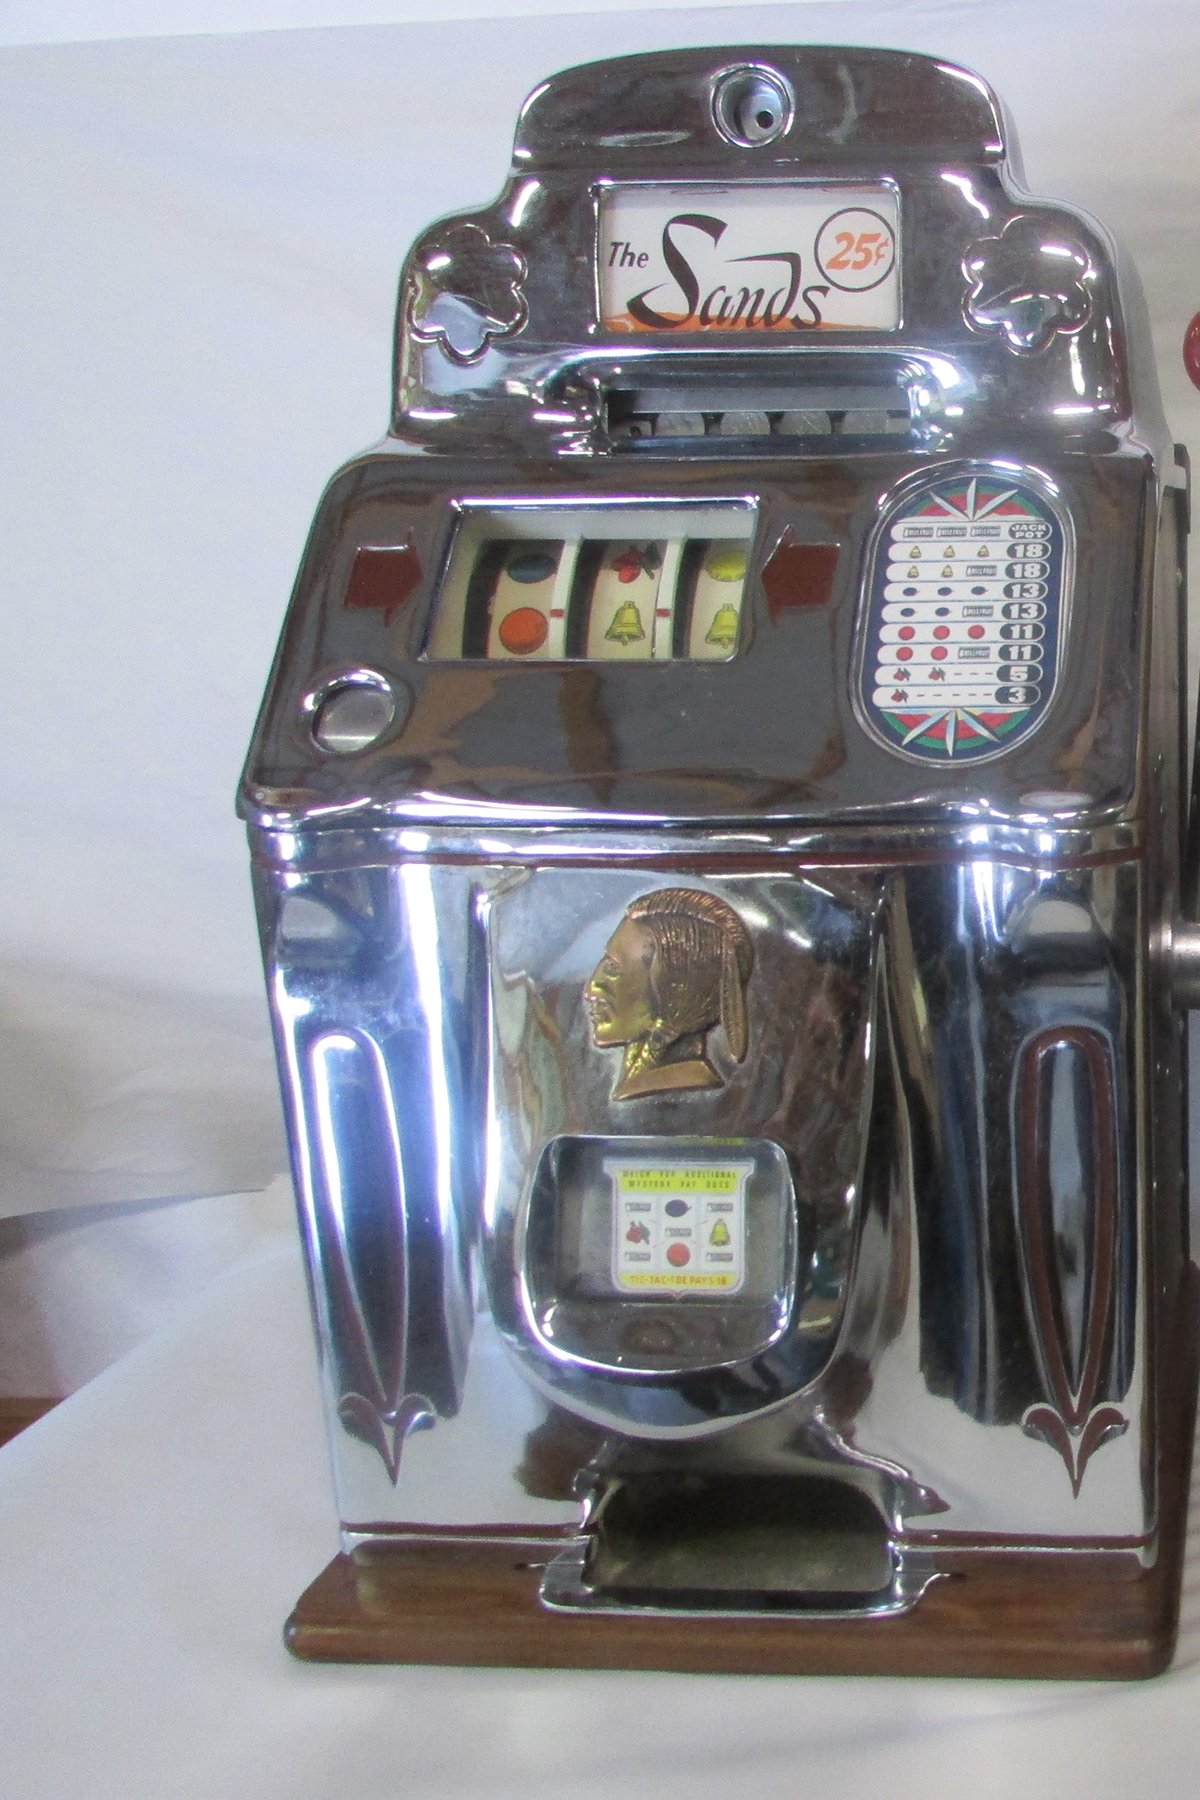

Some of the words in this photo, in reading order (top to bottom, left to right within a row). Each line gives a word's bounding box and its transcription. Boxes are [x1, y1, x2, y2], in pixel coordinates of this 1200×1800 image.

[607, 241, 650, 269] The
[626, 213, 831, 329] Sands
[1011, 524, 1047, 532] JACK
[1015, 531, 1044, 539] POT
[1014, 543, 1044, 559] 18
[1012, 562, 1042, 578] 18
[1011, 583, 1040, 598] 13
[1009, 603, 1039, 619] 13
[1009, 624, 1034, 640] 11
[1008, 645, 1033, 660] 11
[1009, 666, 1028, 682] 5
[1007, 686, 1026, 703] 3
